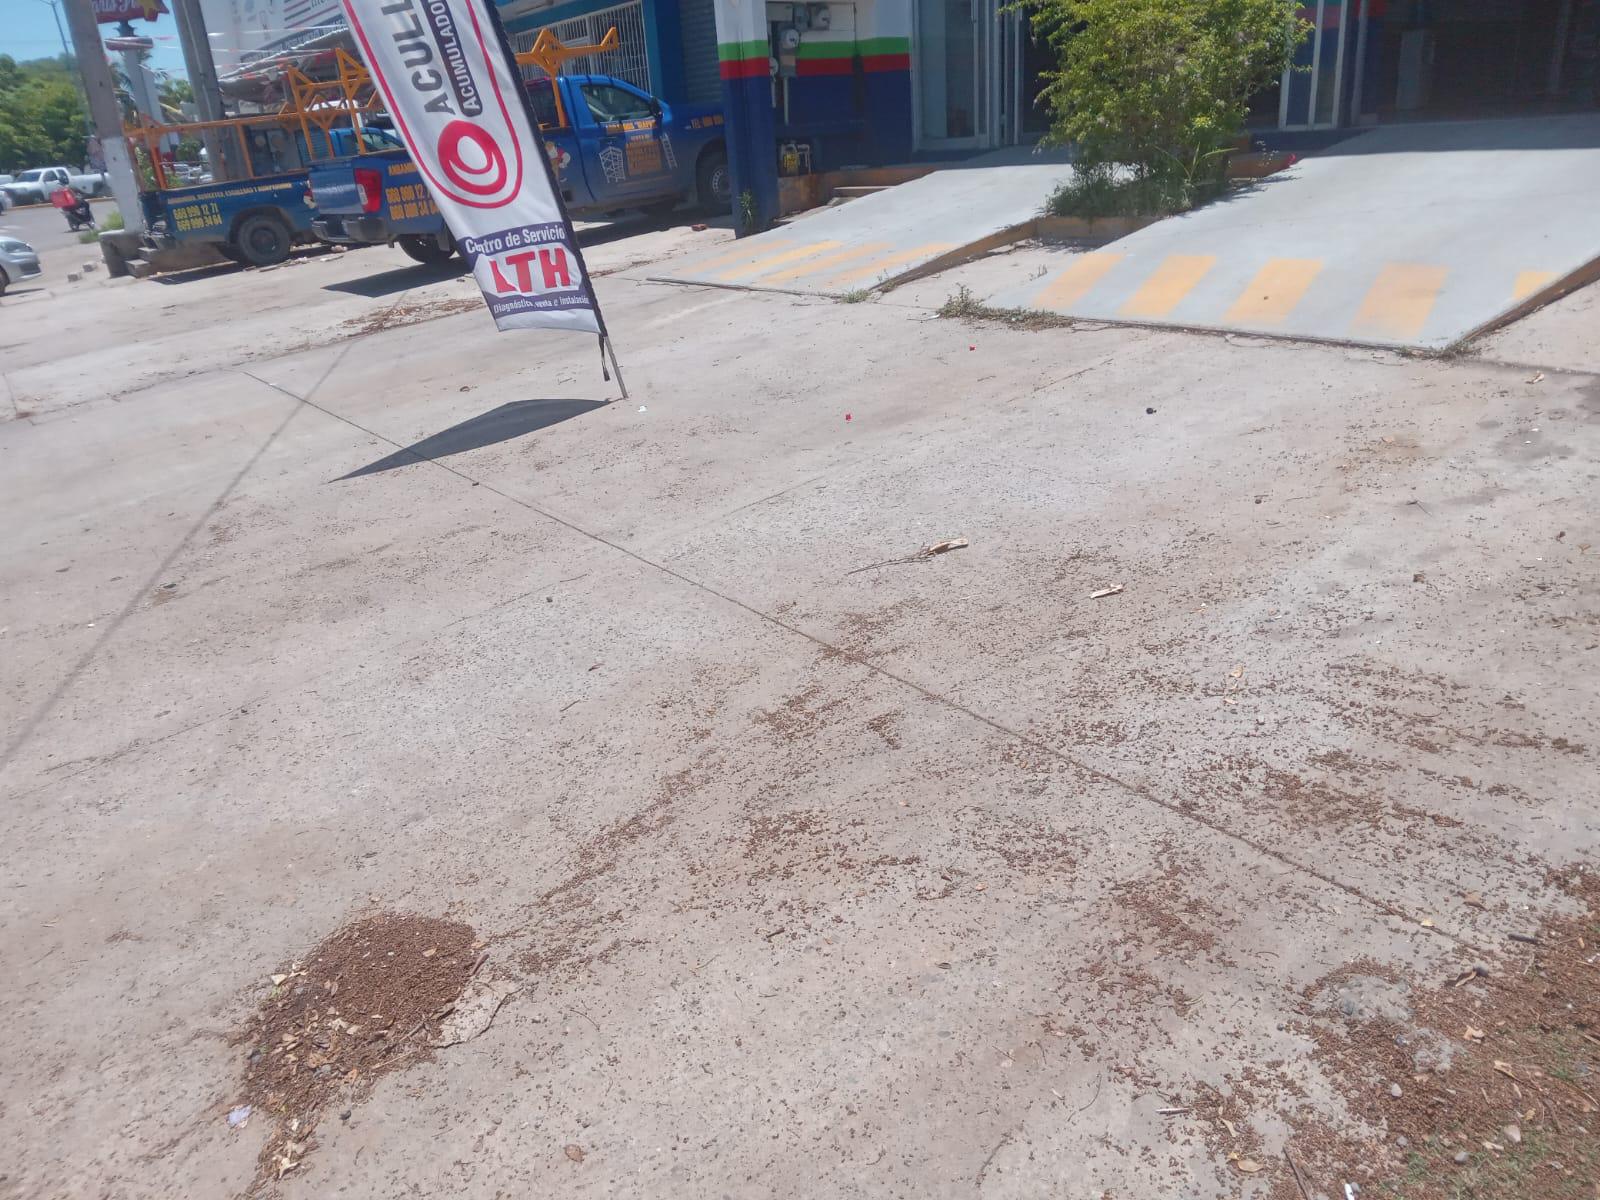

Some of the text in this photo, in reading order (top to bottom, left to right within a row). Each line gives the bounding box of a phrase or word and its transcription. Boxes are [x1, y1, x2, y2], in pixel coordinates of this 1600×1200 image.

[430, 0, 480, 110] ACUMULADO
[505, 231, 520, 248] de
[522, 224, 566, 244] Servicio
[488, 246, 571, 294] LTH
